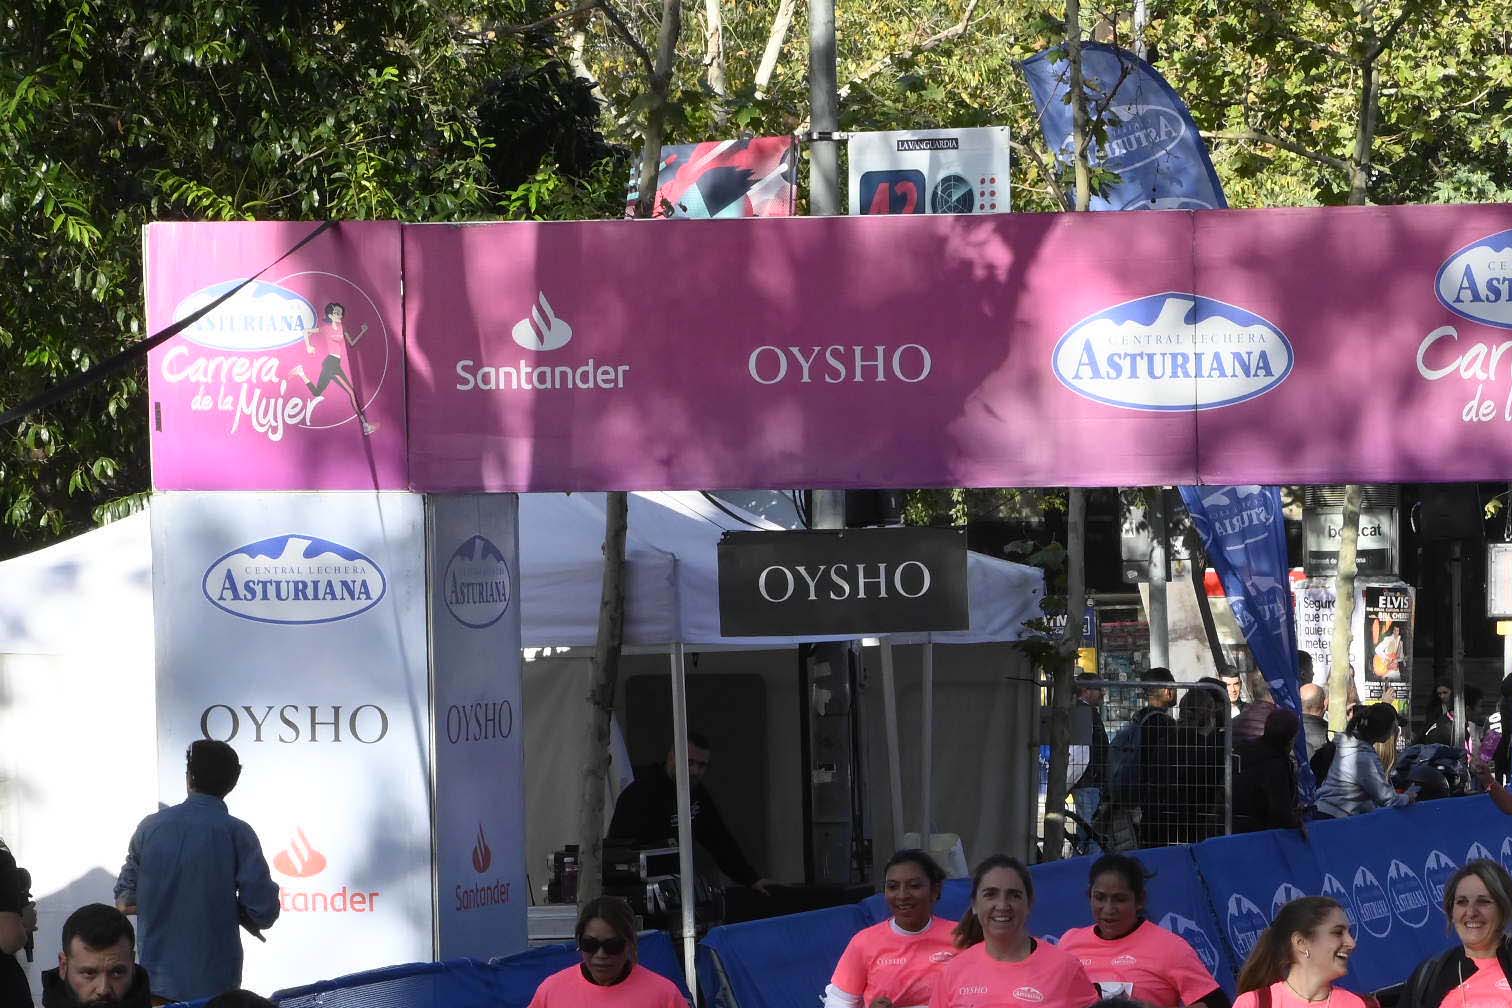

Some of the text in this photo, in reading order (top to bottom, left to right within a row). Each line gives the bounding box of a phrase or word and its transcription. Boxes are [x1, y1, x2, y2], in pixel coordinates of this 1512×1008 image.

[1108, 331, 1267, 347] CENTRAL LECHERA
[161, 346, 280, 384] Carrera
[456, 359, 629, 392] Santander
[747, 343, 932, 384] OYSHO
[1071, 338, 1275, 381] ASTURIANA
[191, 381, 325, 442] de la Mujer
[1463, 384, 1496, 423] de
[218, 569, 373, 602] ASTURIANA
[245, 565, 367, 575] CENTRAL LECHERA
[449, 570, 508, 605] ASTURIANA
[758, 561, 932, 602] OYSHO
[1304, 613, 1320, 624] que
[1378, 596, 1410, 608] ELVIS
[200, 703, 389, 744] OYSHO
[446, 699, 513, 744] OYSHO
[279, 887, 380, 913] tander
[455, 880, 511, 912] Santander
